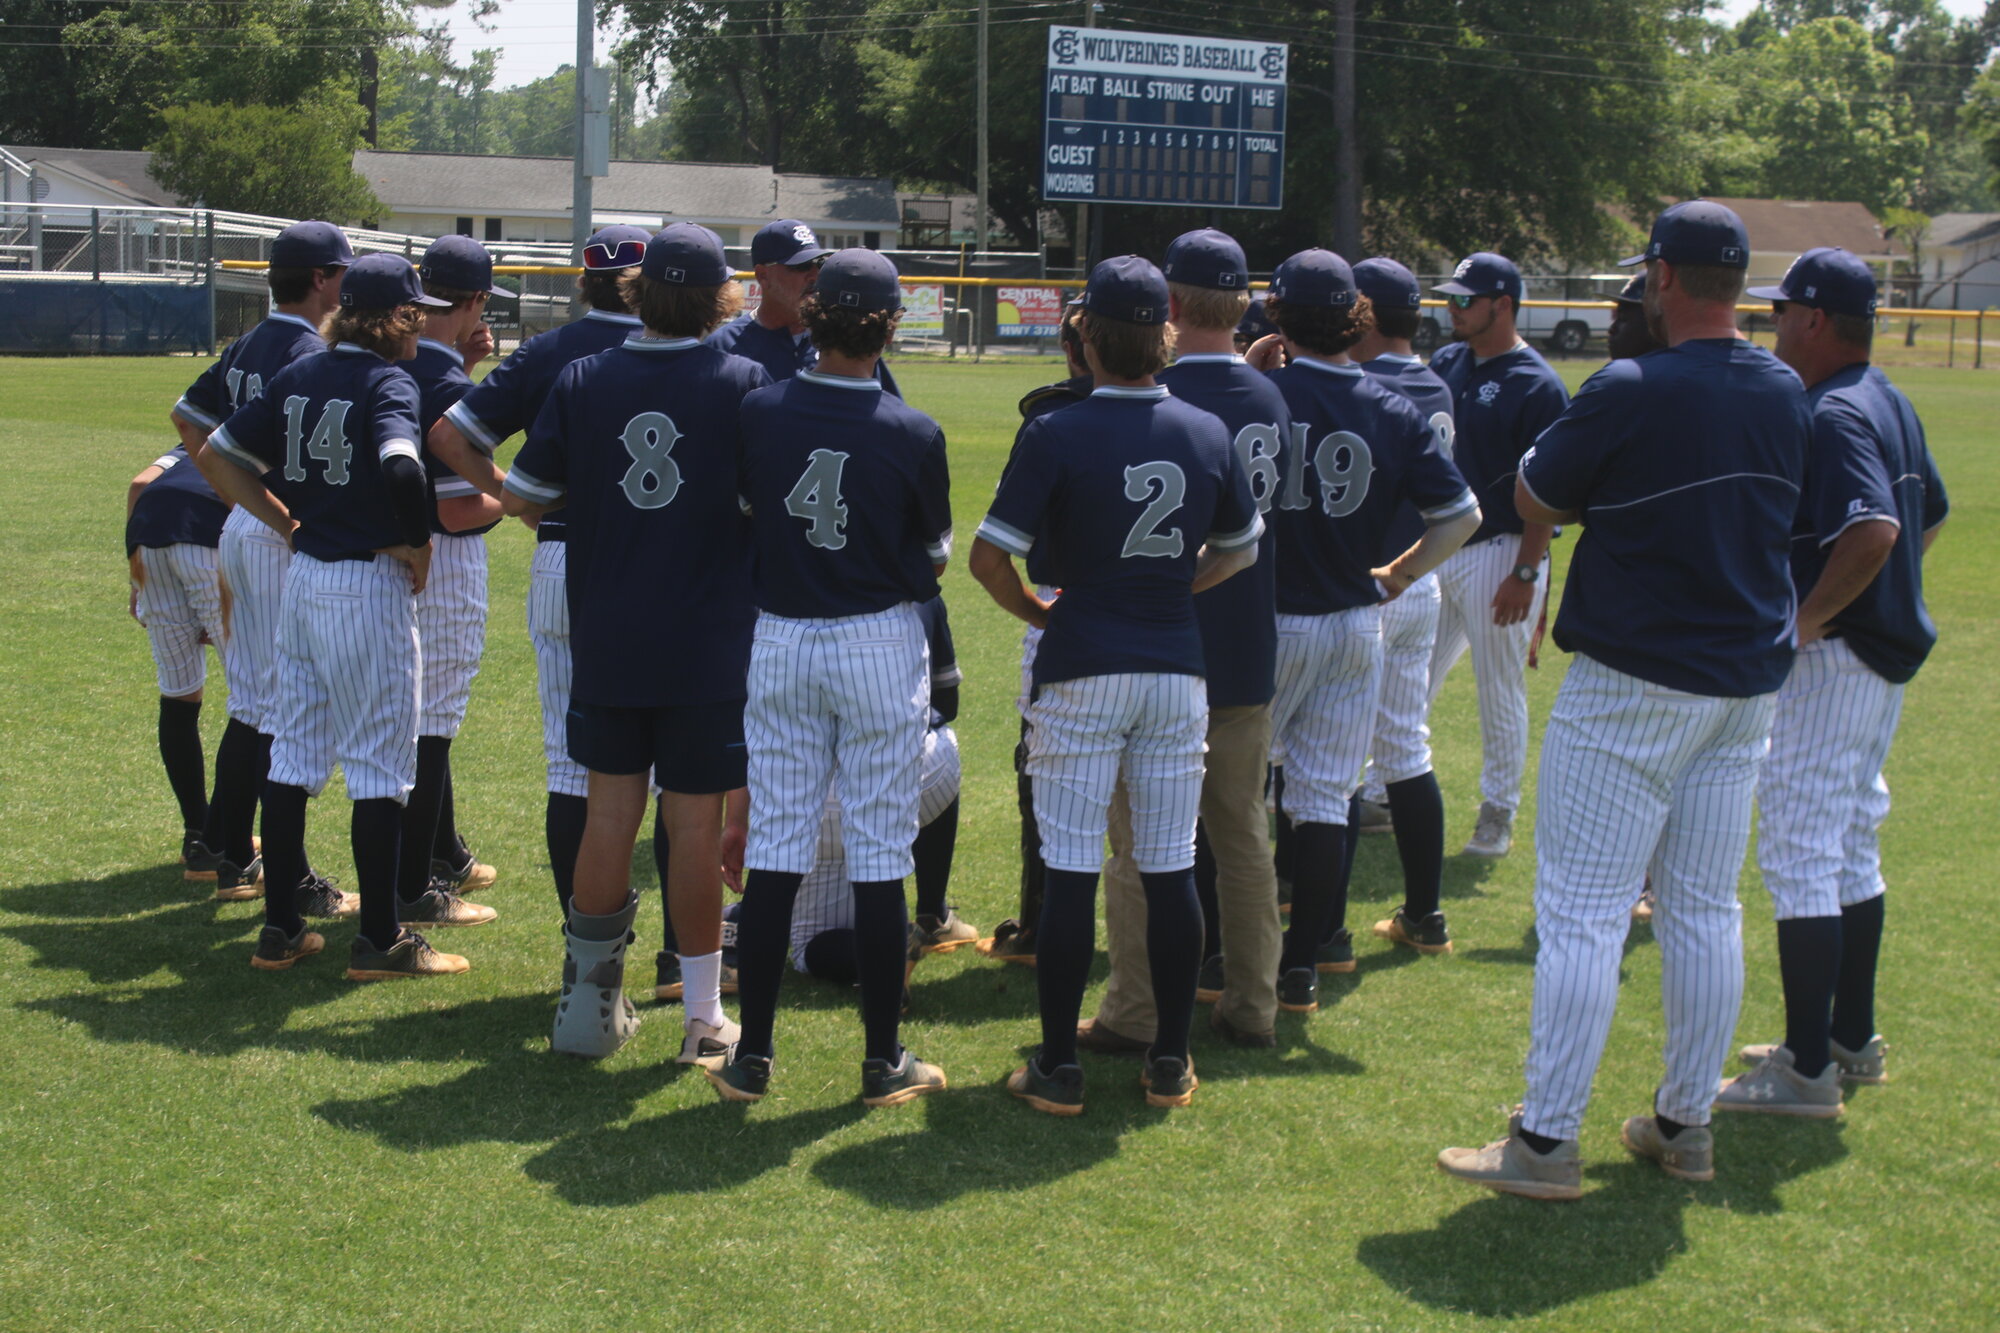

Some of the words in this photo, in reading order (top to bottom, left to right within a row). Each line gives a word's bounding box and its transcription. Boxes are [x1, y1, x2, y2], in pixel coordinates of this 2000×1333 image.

[1082, 36, 1179, 67] WOLVERINES
[1183, 44, 1257, 72] BASEBALL
[1050, 74, 1069, 94] AT
[1071, 75, 1097, 95] BAT
[1103, 78, 1142, 98] BALL
[1147, 81, 1195, 102] STRIKE
[1201, 85, 1235, 104] OUT
[1251, 88, 1276, 107] H/E
[1048, 144, 1095, 166] GUEST
[1102, 129, 1108, 143] 1
[1118, 130, 1125, 144] 2
[1134, 131, 1141, 145] 3
[1150, 132, 1157, 146] 4
[1166, 132, 1173, 147] 5
[1181, 133, 1188, 148] 6
[1197, 134, 1204, 148] 7
[1212, 135, 1220, 149] 8
[1228, 136, 1235, 150] 9
[1244, 137, 1279, 152] TOTAL
[1046, 172, 1095, 194] WOLVERINES
[997, 288, 1059, 300] CENTRAL
[1000, 325, 1031, 336] HWY
[1033, 325, 1058, 336] 378
[284, 395, 354, 486] 14
[617, 411, 685, 510] 8
[1280, 422, 1377, 518] 19
[784, 448, 850, 550] 4
[1120, 460, 1187, 559] 2
